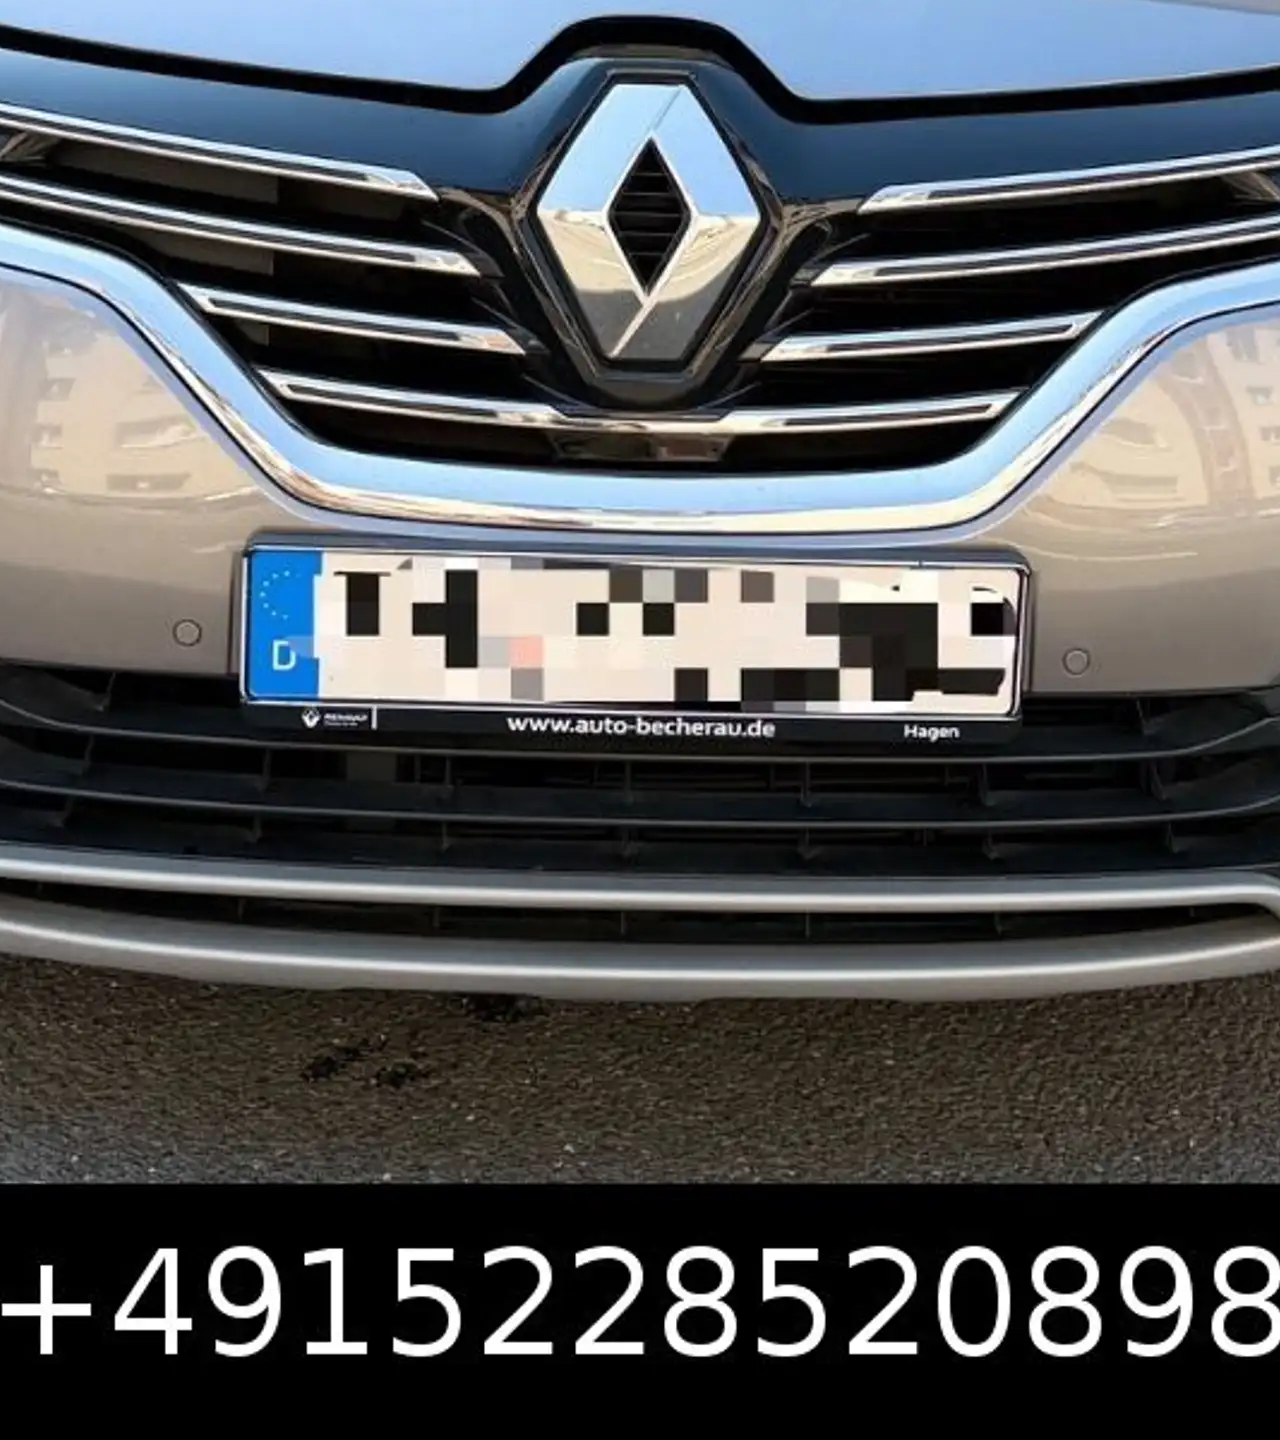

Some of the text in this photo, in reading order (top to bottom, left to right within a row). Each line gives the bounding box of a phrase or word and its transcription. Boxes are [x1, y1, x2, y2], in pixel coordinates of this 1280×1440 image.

[272, 639, 297, 672] D
[506, 714, 777, 739] www.auto-becherau.de
[904, 722, 961, 741] Hagen
